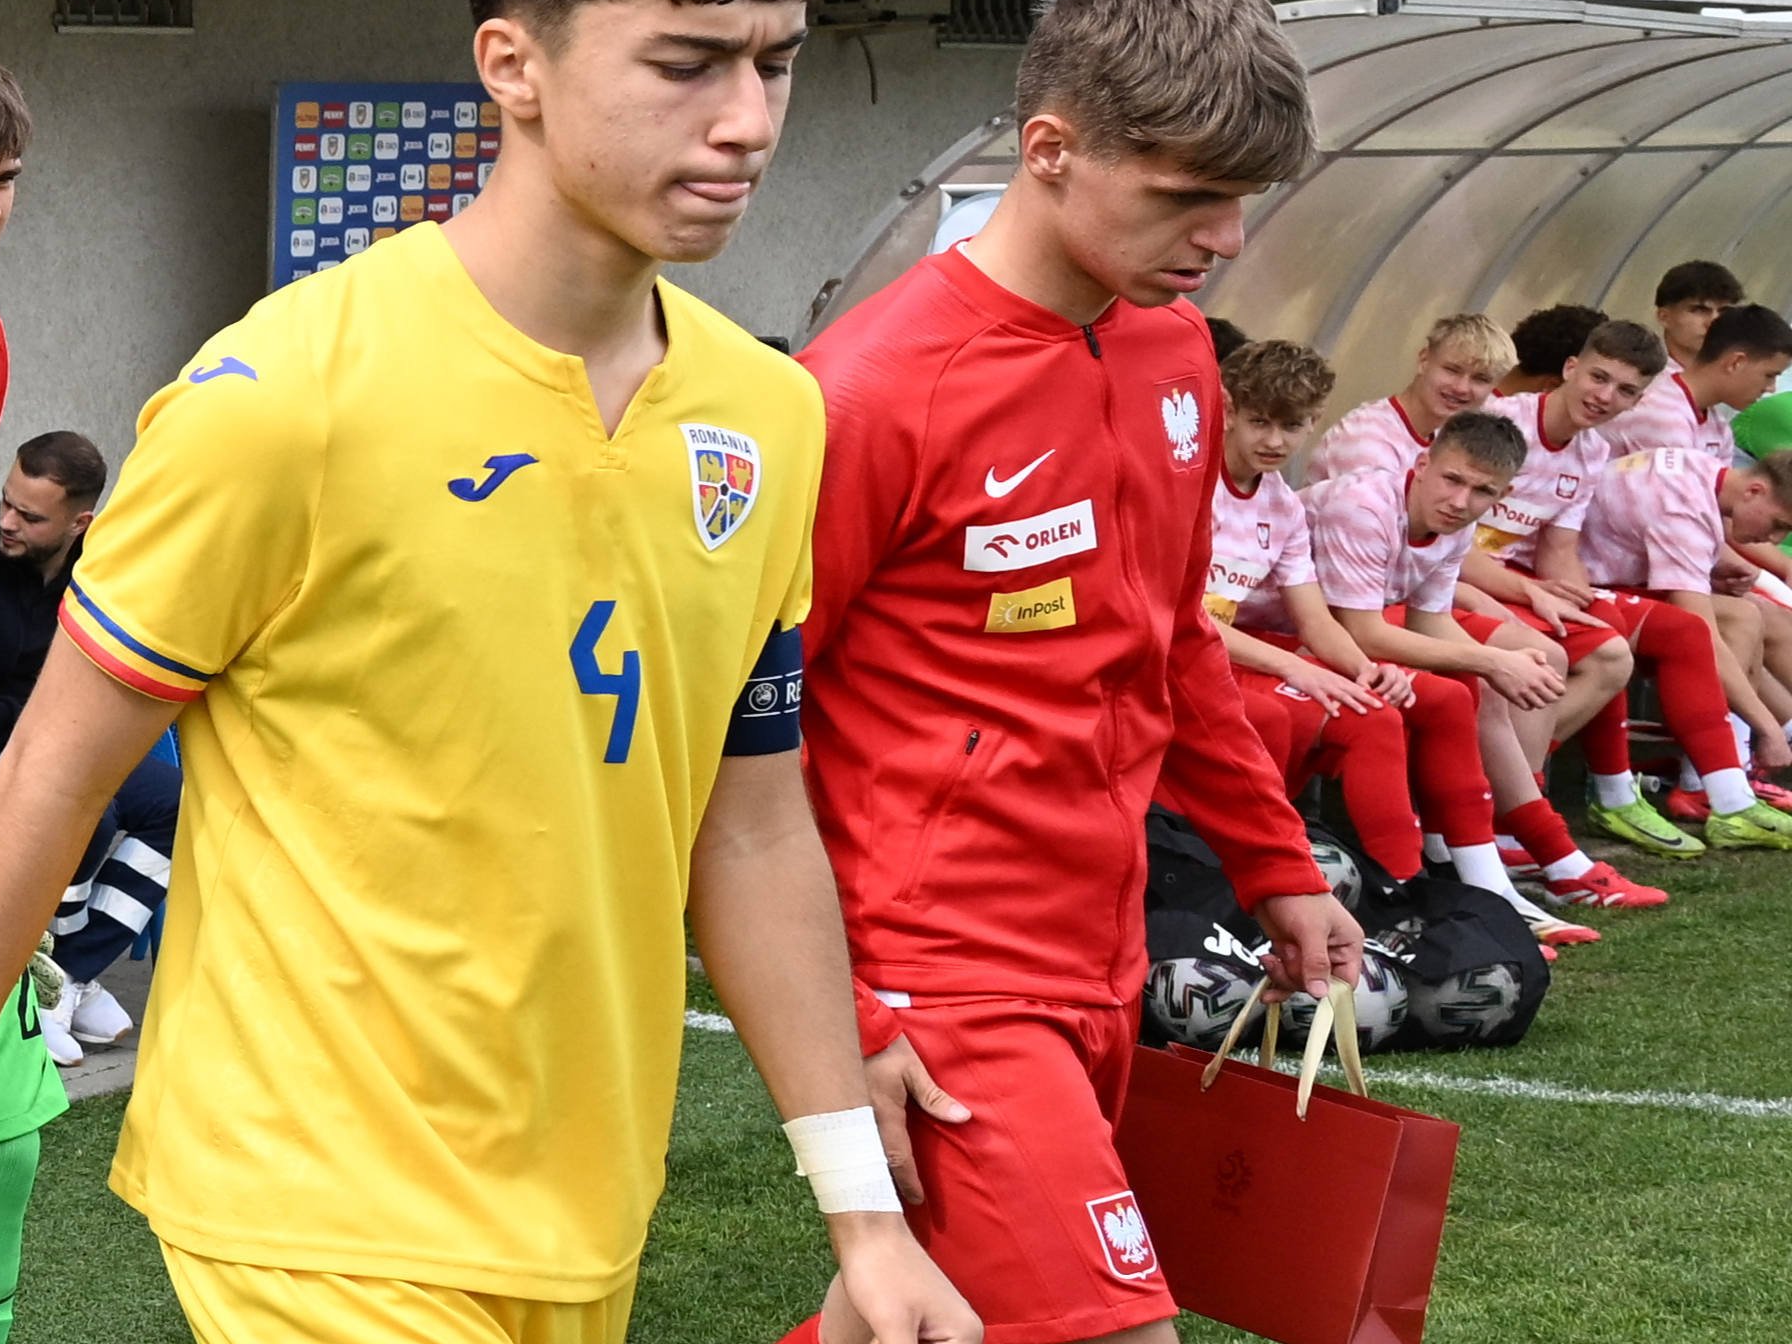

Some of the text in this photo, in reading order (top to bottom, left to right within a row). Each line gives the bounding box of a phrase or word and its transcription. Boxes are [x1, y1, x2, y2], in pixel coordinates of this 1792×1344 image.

[1025, 519, 1082, 550] ORLEN
[1017, 596, 1065, 620] InPost
[569, 600, 641, 763] 4
